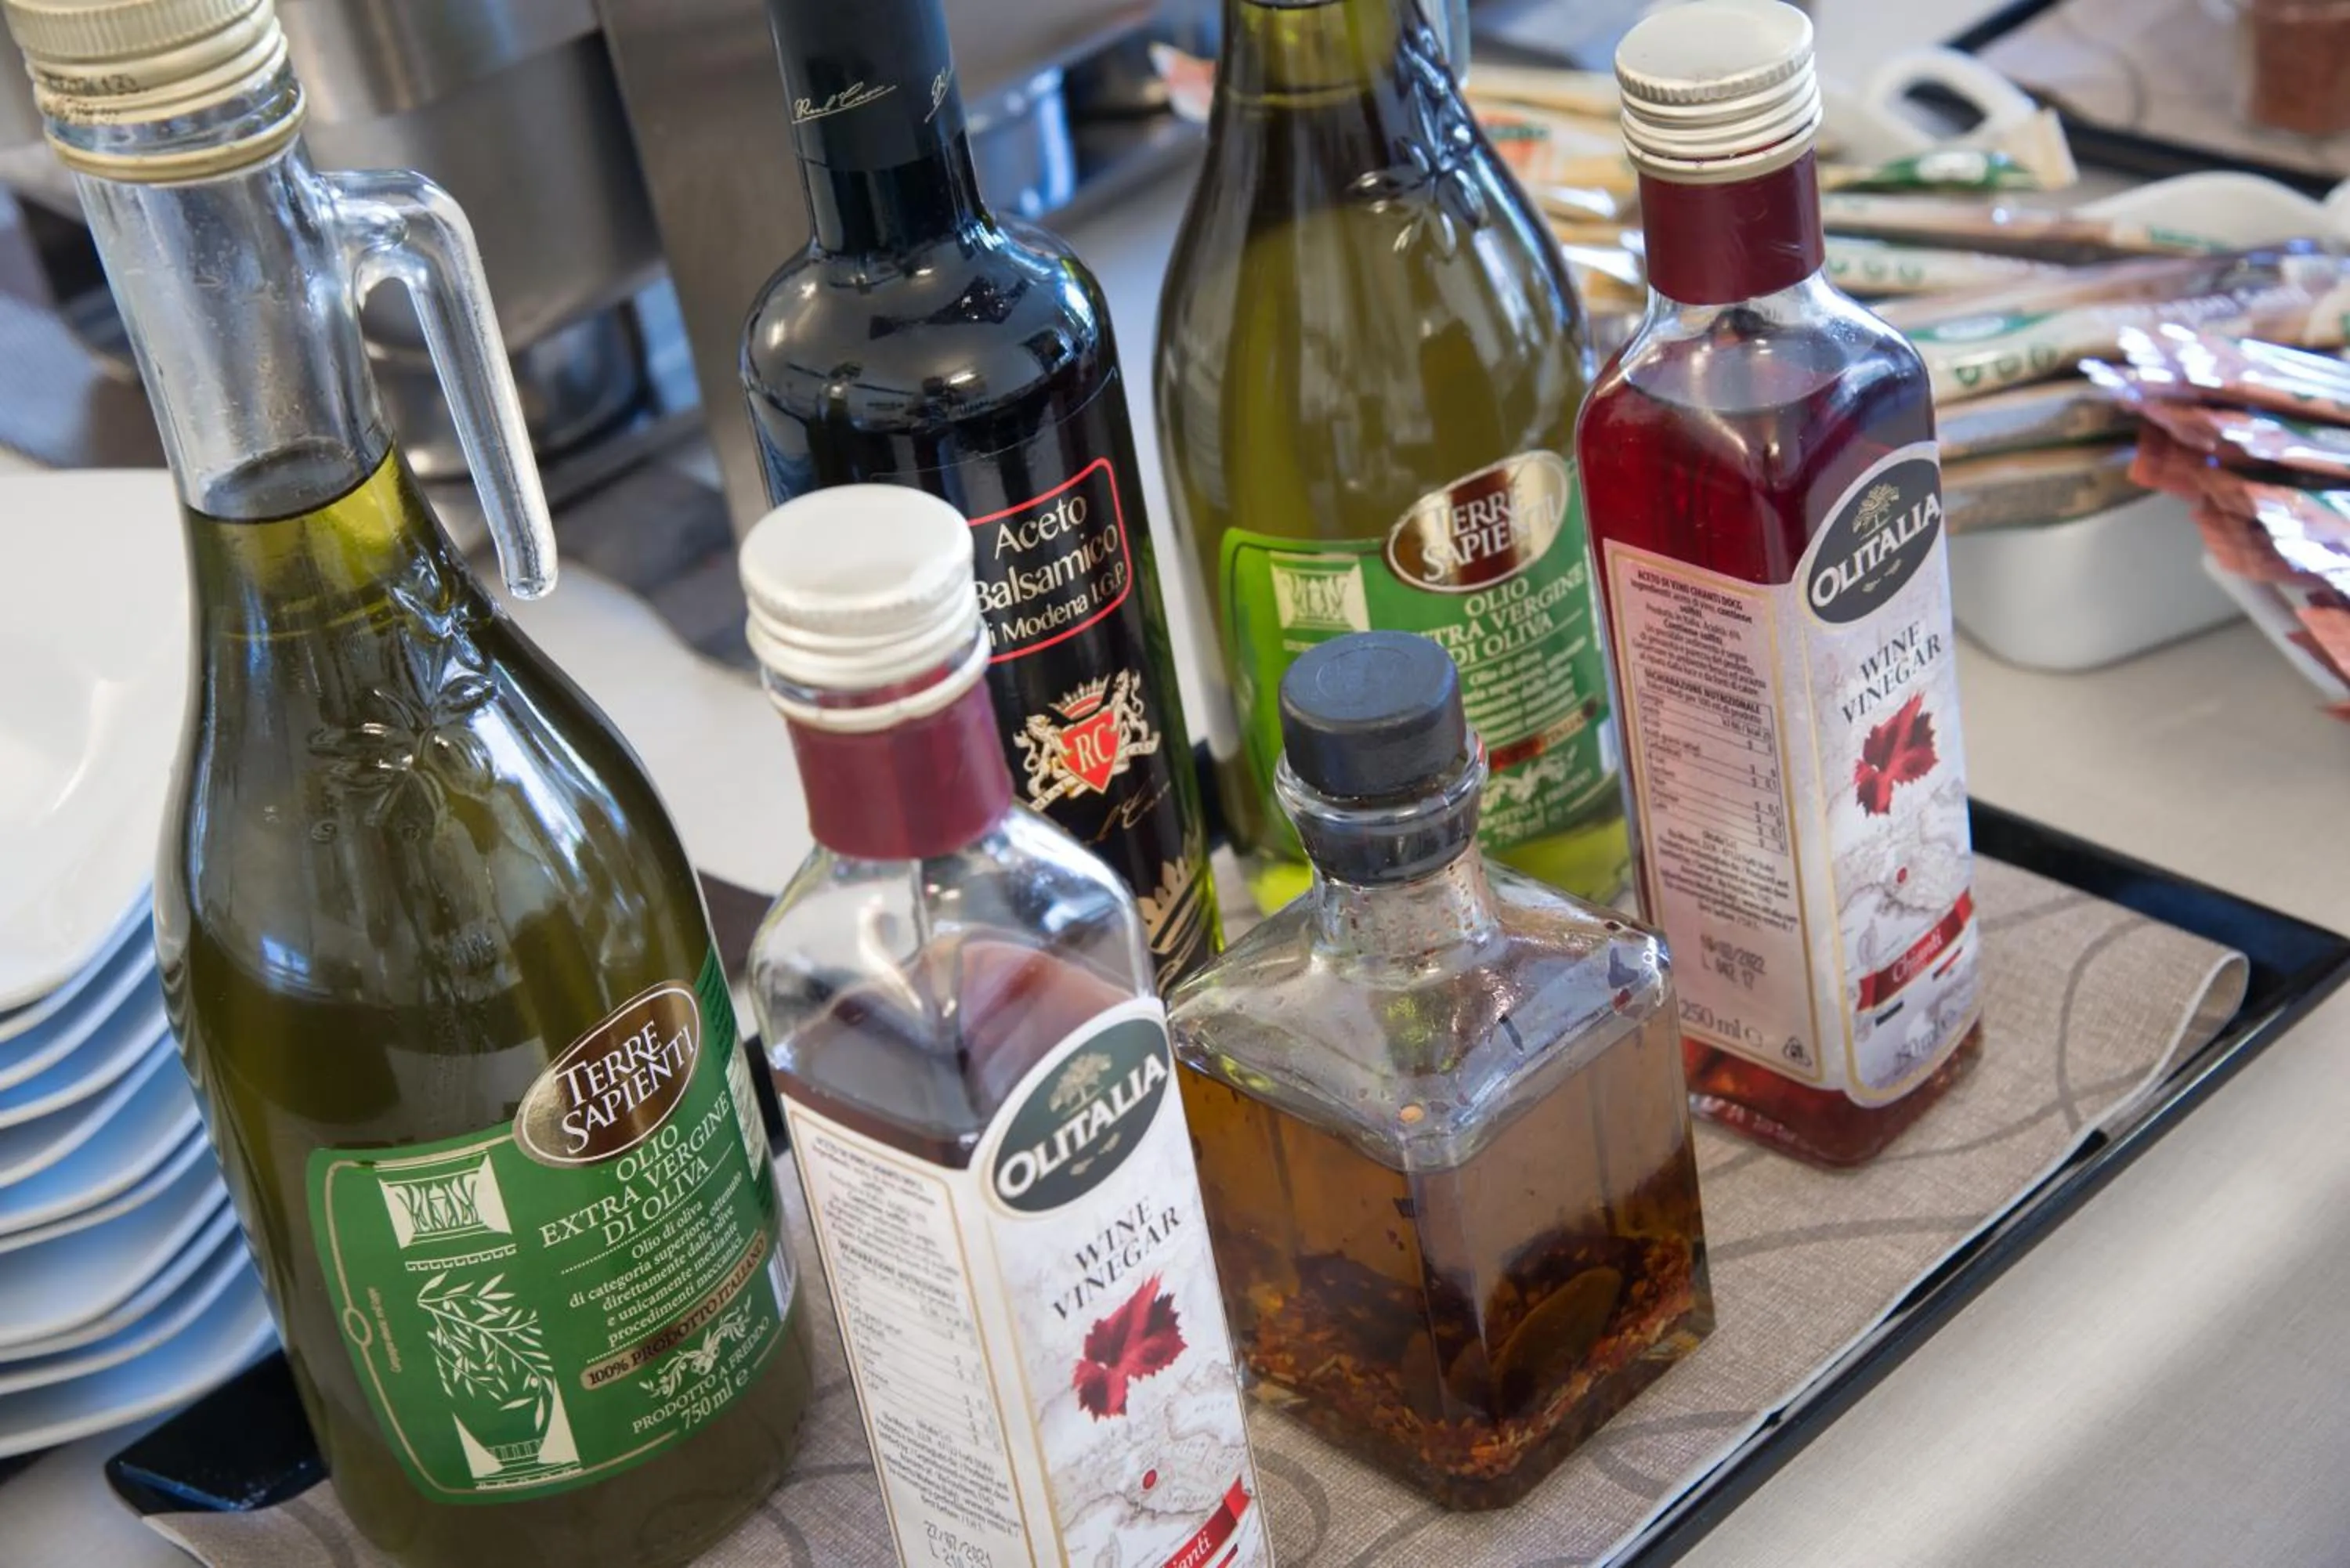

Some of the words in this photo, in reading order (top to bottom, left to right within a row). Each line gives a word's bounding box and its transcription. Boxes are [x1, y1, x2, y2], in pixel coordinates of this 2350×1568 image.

[994, 496, 1086, 560] Aceto
[1812, 493, 1941, 607] OLITALIA
[974, 524, 1118, 614] Balsamico
[1464, 578, 1528, 616] OLIO
[1491, 562, 1585, 629] VERGINE
[1001, 594, 1088, 643] Modena
[1449, 643, 1477, 667] DI
[1483, 612, 1553, 656] OLIVA
[1859, 622, 1922, 682] WINE
[1842, 634, 1941, 724] VINEGAR
[1075, 722, 1114, 773] RC
[554, 1020, 662, 1107] TERRE
[562, 1024, 695, 1154] SAPIENTI
[616, 1125, 678, 1181] OLIO
[997, 1053, 1167, 1199] OLITALIA
[538, 1184, 641, 1248] EXTRA
[643, 1091, 730, 1188] VERGINE
[602, 1212, 637, 1247] DI
[642, 1157, 710, 1220] OLIVA
[631, 1234, 660, 1259] Olio
[663, 1221, 676, 1239] di
[676, 1201, 703, 1227] oliva
[1052, 1207, 1180, 1321] VINEGAR
[1075, 1196, 1151, 1273] WINE
[569, 1291, 585, 1309] di
[588, 1261, 652, 1300] categoria
[602, 1256, 686, 1311] direttamente
[687, 1231, 713, 1257] dalle
[607, 1315, 616, 1327] e
[619, 1267, 692, 1321] unicamente
[693, 1221, 738, 1272] mediante
[588, 1359, 629, 1386] 100%
[631, 1298, 718, 1367] PRODOTTO
[717, 1237, 766, 1305] ITALIANO
[607, 1286, 696, 1347] procedimenti
[632, 1374, 716, 1434] PRODOTTO
[719, 1365, 728, 1380] A
[727, 1316, 771, 1370] FREDDO
[681, 1395, 711, 1430] 750
[712, 1376, 735, 1410] ml
